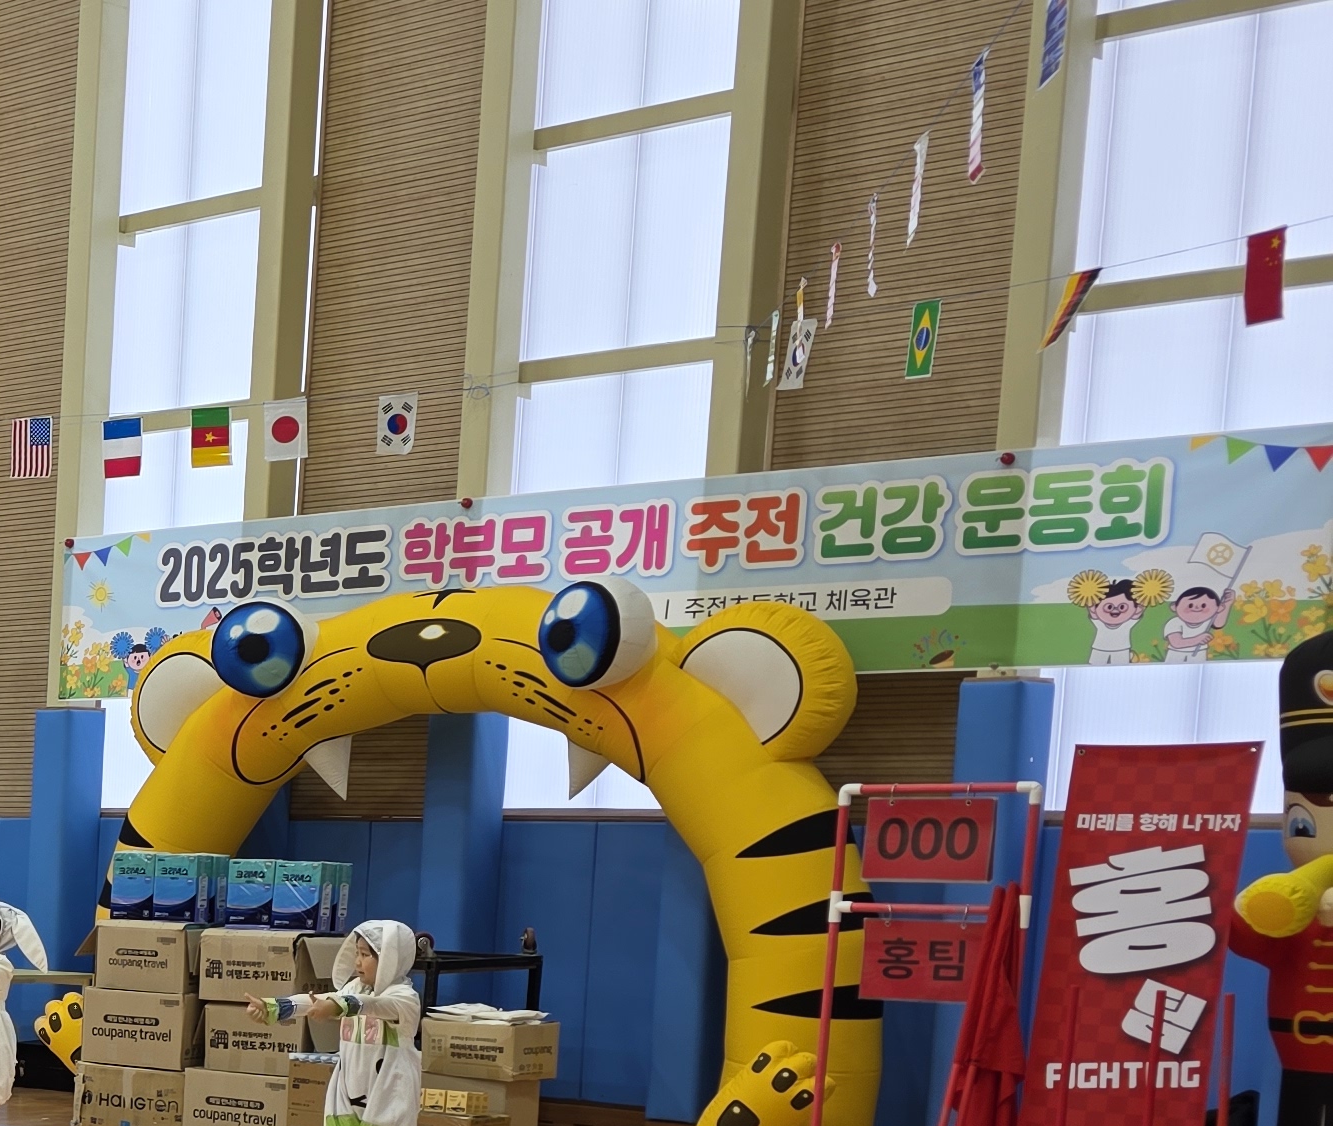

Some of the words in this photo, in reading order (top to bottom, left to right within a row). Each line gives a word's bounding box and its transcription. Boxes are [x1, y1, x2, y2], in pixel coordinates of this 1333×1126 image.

[159, 528, 387, 601] 2025학년도
[403, 516, 546, 585] 학부모
[564, 504, 667, 576] 공개
[688, 493, 801, 568] 주전
[819, 481, 945, 559] 건강
[962, 463, 1167, 549] 운동회
[826, 587, 897, 611] 체육관
[1076, 813, 1134, 832] 미래를
[1139, 813, 1176, 832] 향해
[1182, 813, 1241, 832] 나가자
[877, 816, 980, 861] 000
[108, 957, 143, 970] coupang
[143, 958, 168, 970] travel
[252, 970, 269, 981] 추가
[271, 971, 291, 981] 할인!
[92, 1026, 137, 1043] coupang
[139, 1028, 172, 1042] travel
[258, 1041, 276, 1051] 추가
[1045, 1060, 1201, 1089] FIGHTNG
[193, 1108, 242, 1126] coupang
[243, 1111, 277, 1126] travel
